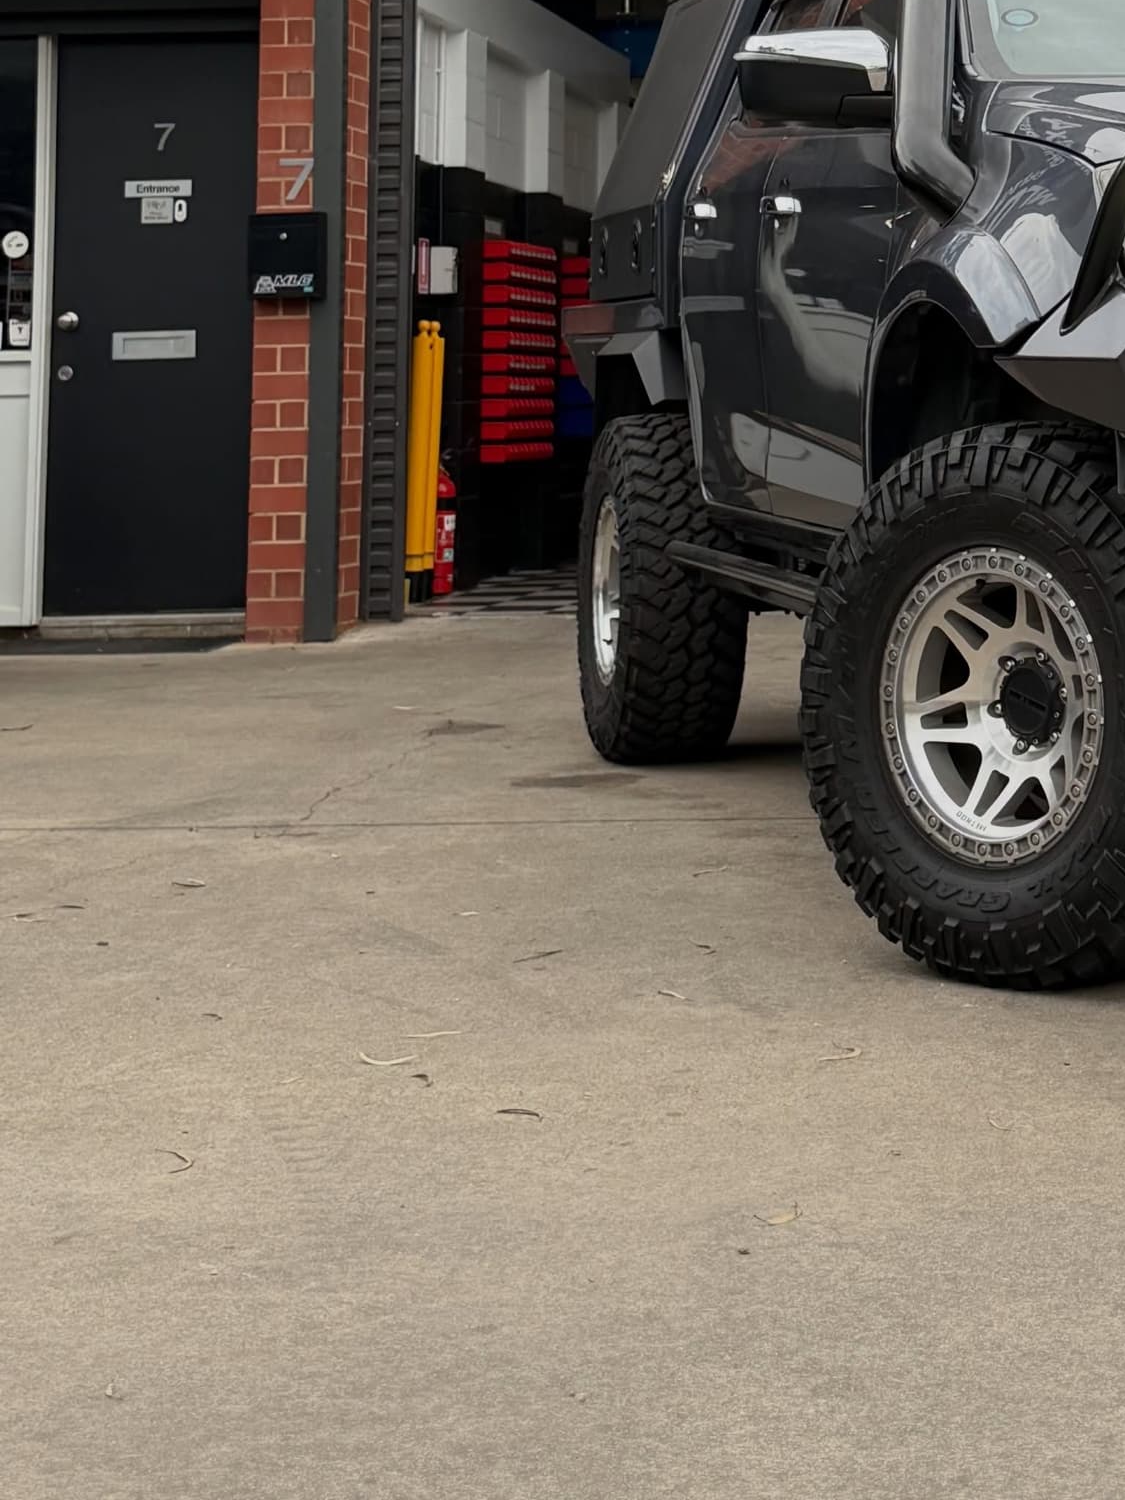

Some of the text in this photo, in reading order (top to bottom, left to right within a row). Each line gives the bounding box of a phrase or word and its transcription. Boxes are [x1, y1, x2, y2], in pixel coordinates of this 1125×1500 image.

[154, 123, 176, 151] 7
[136, 184, 180, 194] Entrance
[279, 158, 314, 201] 7
